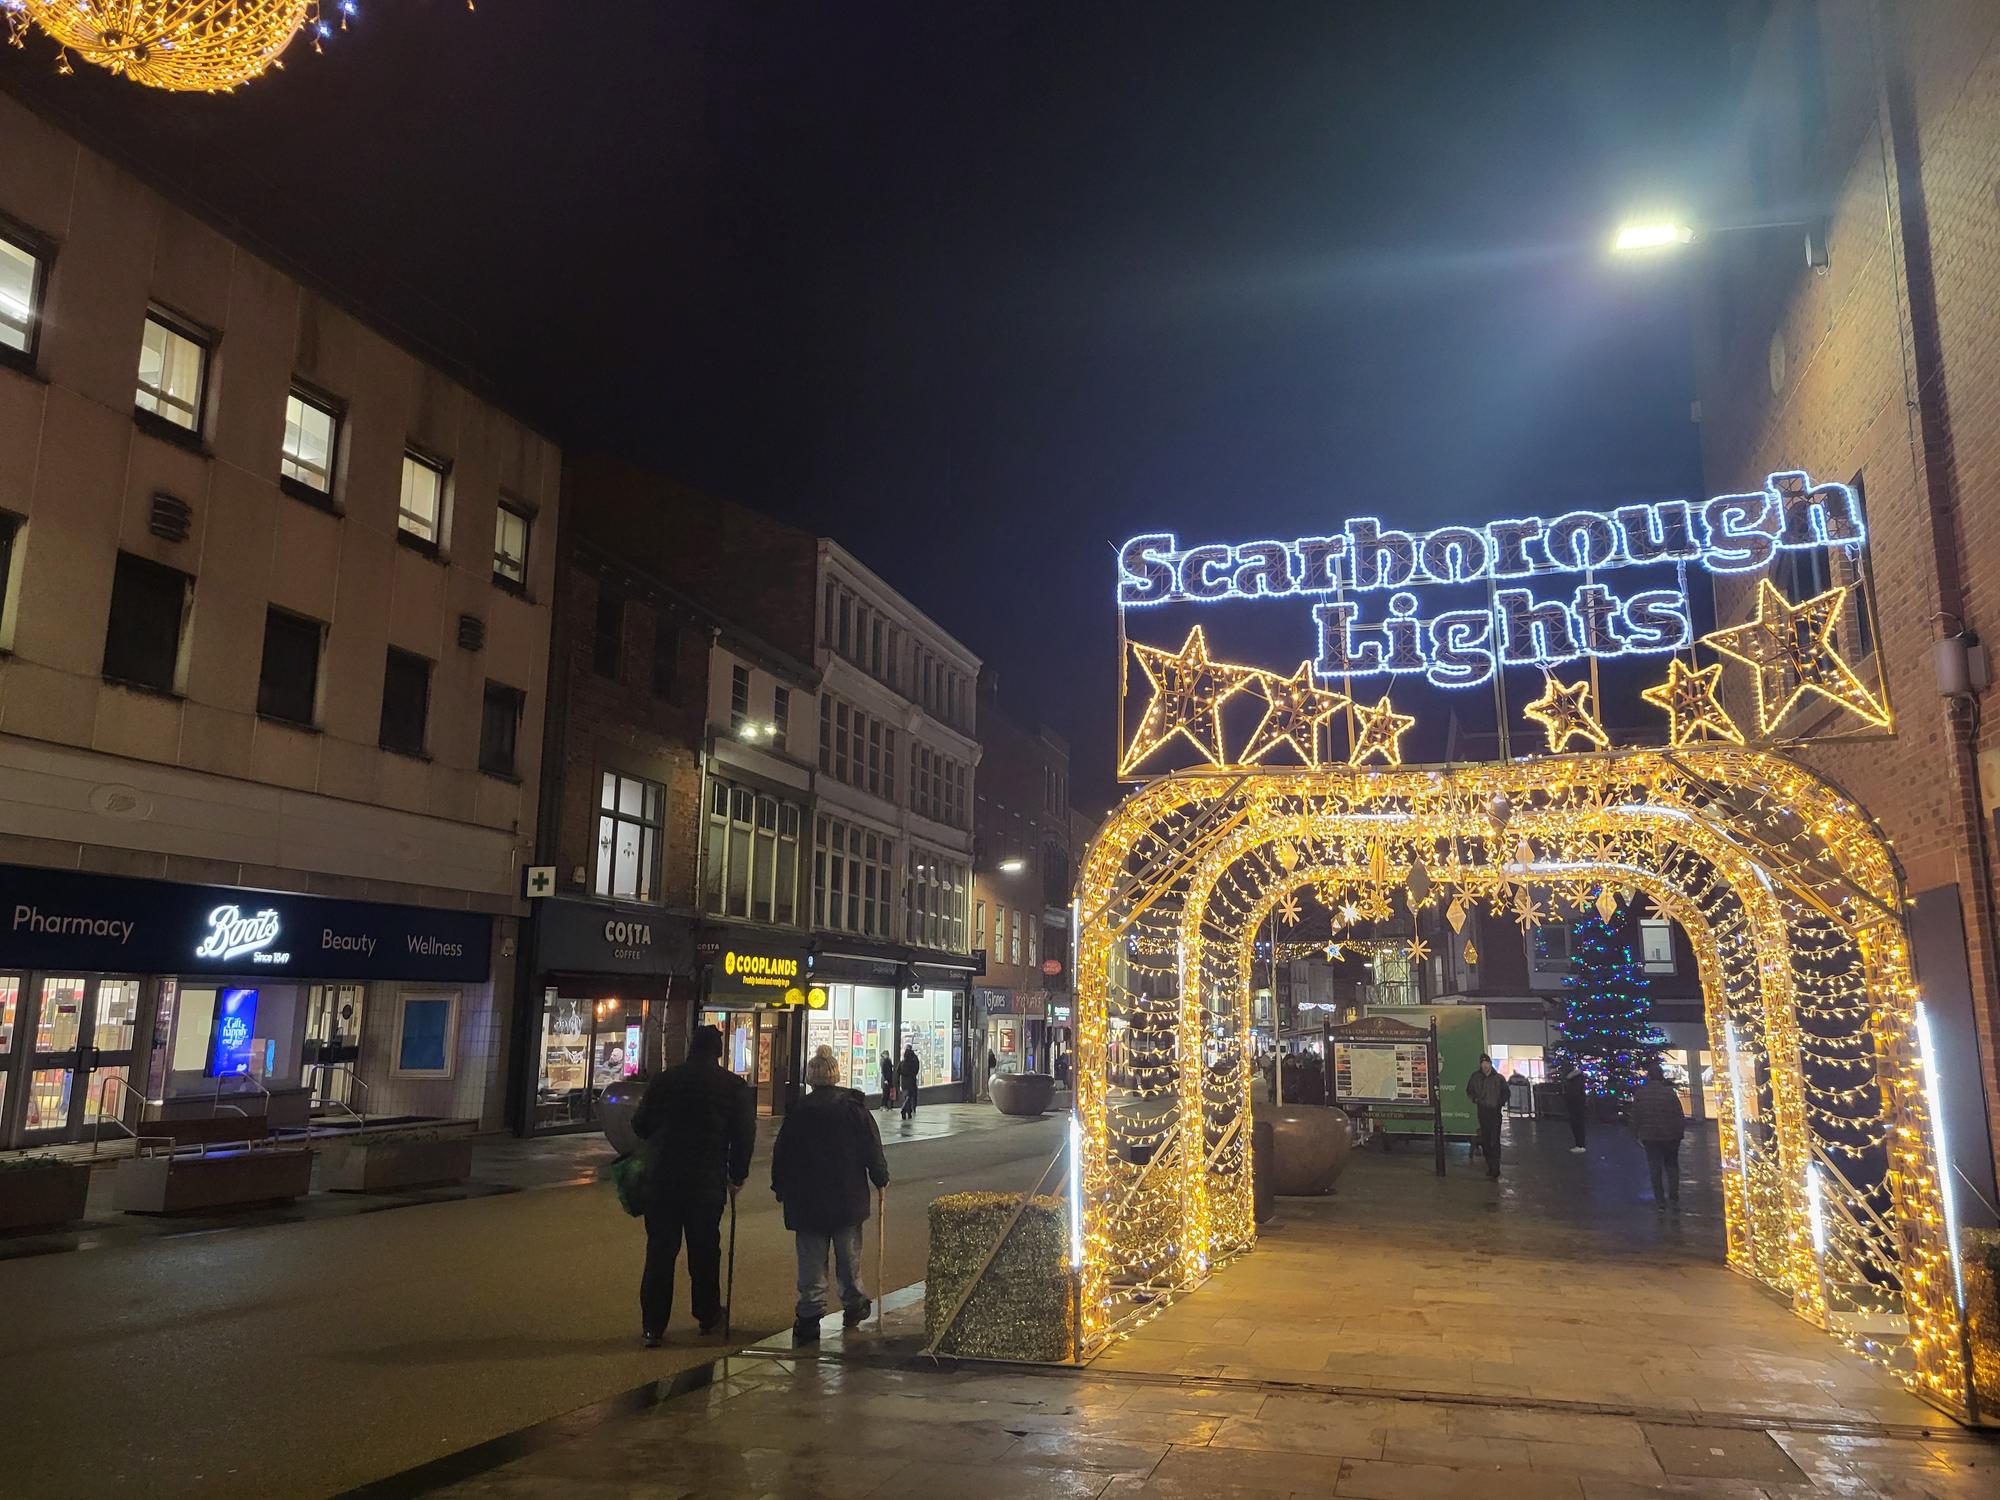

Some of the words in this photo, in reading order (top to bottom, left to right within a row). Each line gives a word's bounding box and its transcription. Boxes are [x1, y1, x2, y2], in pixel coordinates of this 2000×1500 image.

[1117, 470, 1867, 606] Scarborough
[1312, 583, 1693, 689] Lights
[13, 904, 135, 945] Pharmacy
[196, 904, 280, 961] Boots
[605, 920, 652, 947] COSTA
[321, 928, 377, 958] Beauty
[407, 934, 464, 957] Wellness
[614, 949, 641, 960] COFFEE
[253, 951, 273, 964] Since
[273, 952, 290, 964] 1849
[736, 954, 797, 977] COOPLANDS
